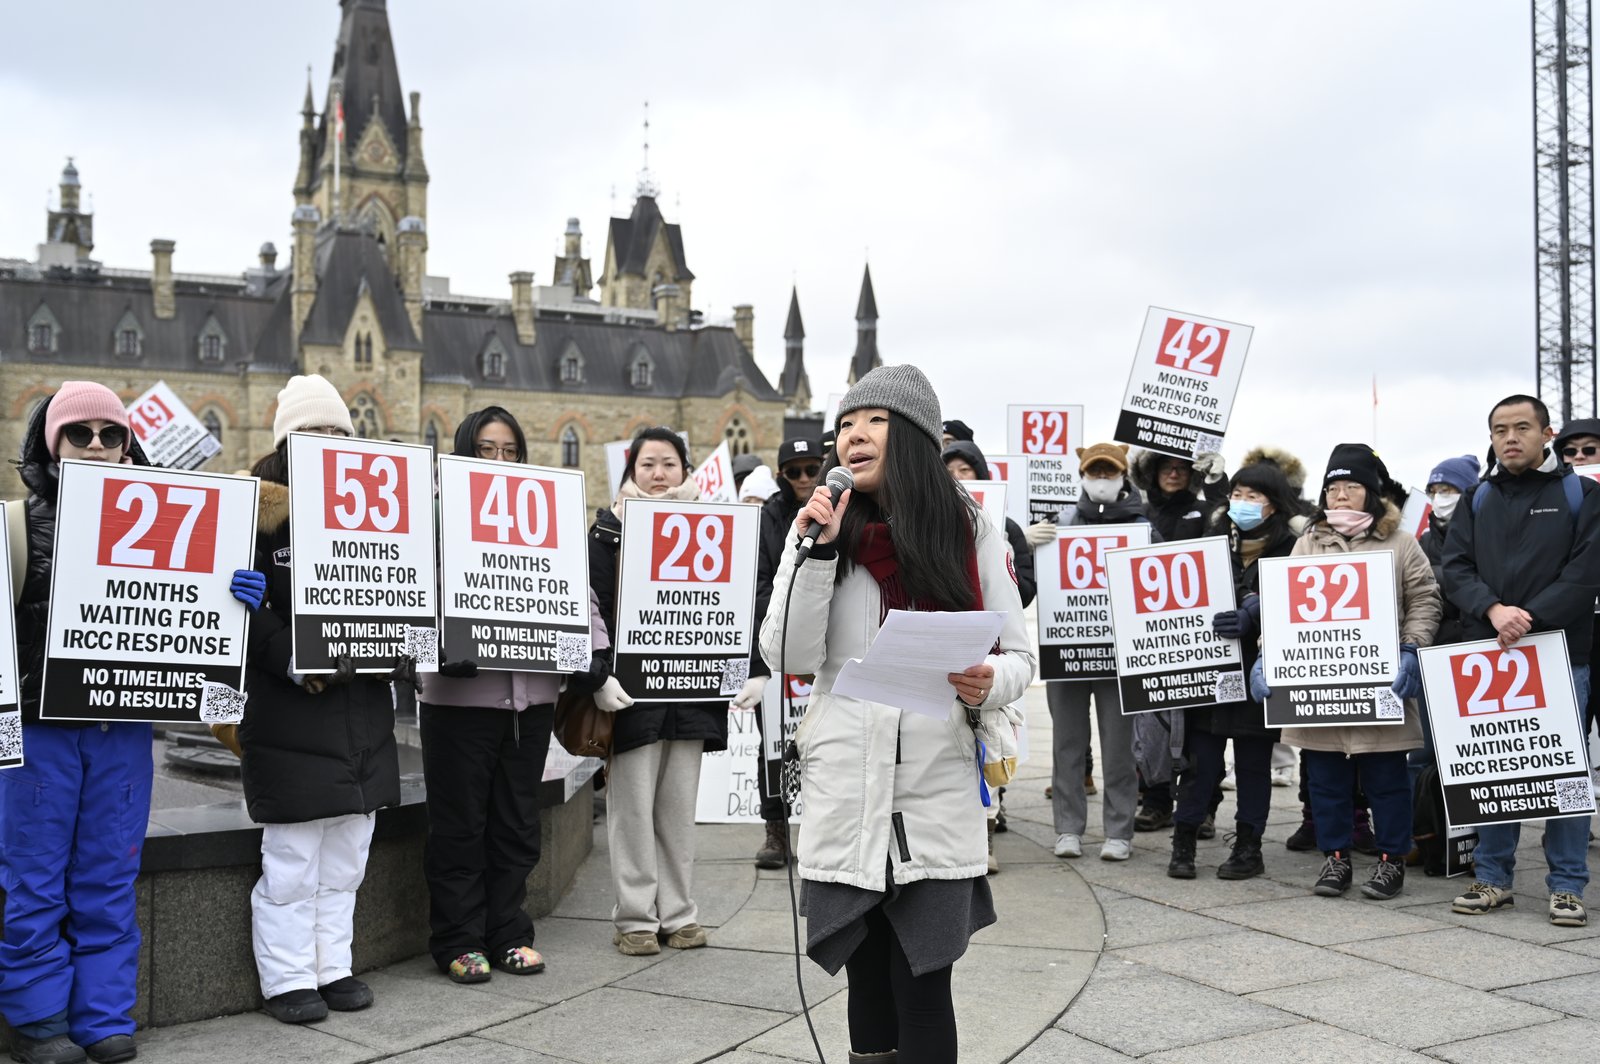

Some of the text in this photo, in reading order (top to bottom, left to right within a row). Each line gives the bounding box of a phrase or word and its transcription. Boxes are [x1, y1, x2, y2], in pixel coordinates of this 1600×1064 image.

[1164, 321, 1221, 375] 42
[1158, 372, 1208, 392] MONTHS
[1143, 383, 1218, 409] WAITING FOR
[131, 400, 168, 437] 19
[1131, 395, 1222, 425] IRCC RESPONSE
[1026, 412, 1063, 454] 32
[1137, 418, 1199, 439] NO TIMELINE
[1138, 430, 1152, 442] NO
[1030, 472, 1071, 483] ITING FOR
[334, 452, 400, 532] 53
[1032, 485, 1077, 496] RESPONSE
[480, 475, 548, 546] 40
[111, 482, 206, 569] 27
[332, 540, 399, 560] MONTHS
[659, 513, 724, 581] 28
[482, 552, 550, 573] MONTHS
[1067, 537, 1118, 589] 65
[314, 563, 417, 584] WAITING FOR
[464, 572, 569, 595] WAITING FOR
[1139, 553, 1199, 612] 90
[106, 579, 199, 603] MONTHS
[305, 587, 426, 608] IRCC RESPONSE
[657, 590, 720, 606] MONTHS
[1297, 564, 1361, 622] 32
[454, 592, 579, 616] IRCC RESPONSE
[80, 604, 220, 630] WAITING FOR
[639, 610, 735, 626] WAITING FOR
[1054, 611, 1107, 623] WAITING
[1146, 615, 1204, 632] MONTHS
[322, 622, 341, 638] NO
[472, 625, 563, 644] NO TIMELINE
[628, 630, 742, 646] IRCC RESPONSE
[1046, 626, 1113, 638] IRCC RESP
[1298, 628, 1361, 643] MONTHS
[63, 629, 231, 656] IRCC RESPONSE
[328, 642, 347, 658] NO
[1133, 631, 1221, 651] WAITING FOR
[478, 643, 557, 661] NO RESULTS
[1060, 649, 1074, 659] NO
[1126, 645, 1231, 668] IRCC RESPONSE
[1283, 645, 1379, 661] WAITING FOR
[642, 660, 727, 673] NO TIMELINES
[1065, 660, 1117, 671] NO RESUL
[1274, 662, 1390, 679] IRCC RESPONSE
[83, 668, 206, 689] NO TIMELINES
[646, 676, 719, 689] NO RESULTS
[1143, 670, 1220, 689] NO TIMELINES
[1462, 649, 1536, 714] 22
[89, 690, 196, 709] NO RESULTS
[1149, 690, 1165, 702] NO
[1290, 688, 1375, 702] NO TIMELINES
[1296, 703, 1371, 716] NO RESULTS
[1471, 718, 1540, 738] MONTHS
[1456, 734, 1562, 758] WAITING FOR
[1450, 751, 1575, 777] IRCC RESPONSE
[1470, 780, 1556, 800] NO TIMELINE
[1479, 796, 1559, 815] NO RESULTS
